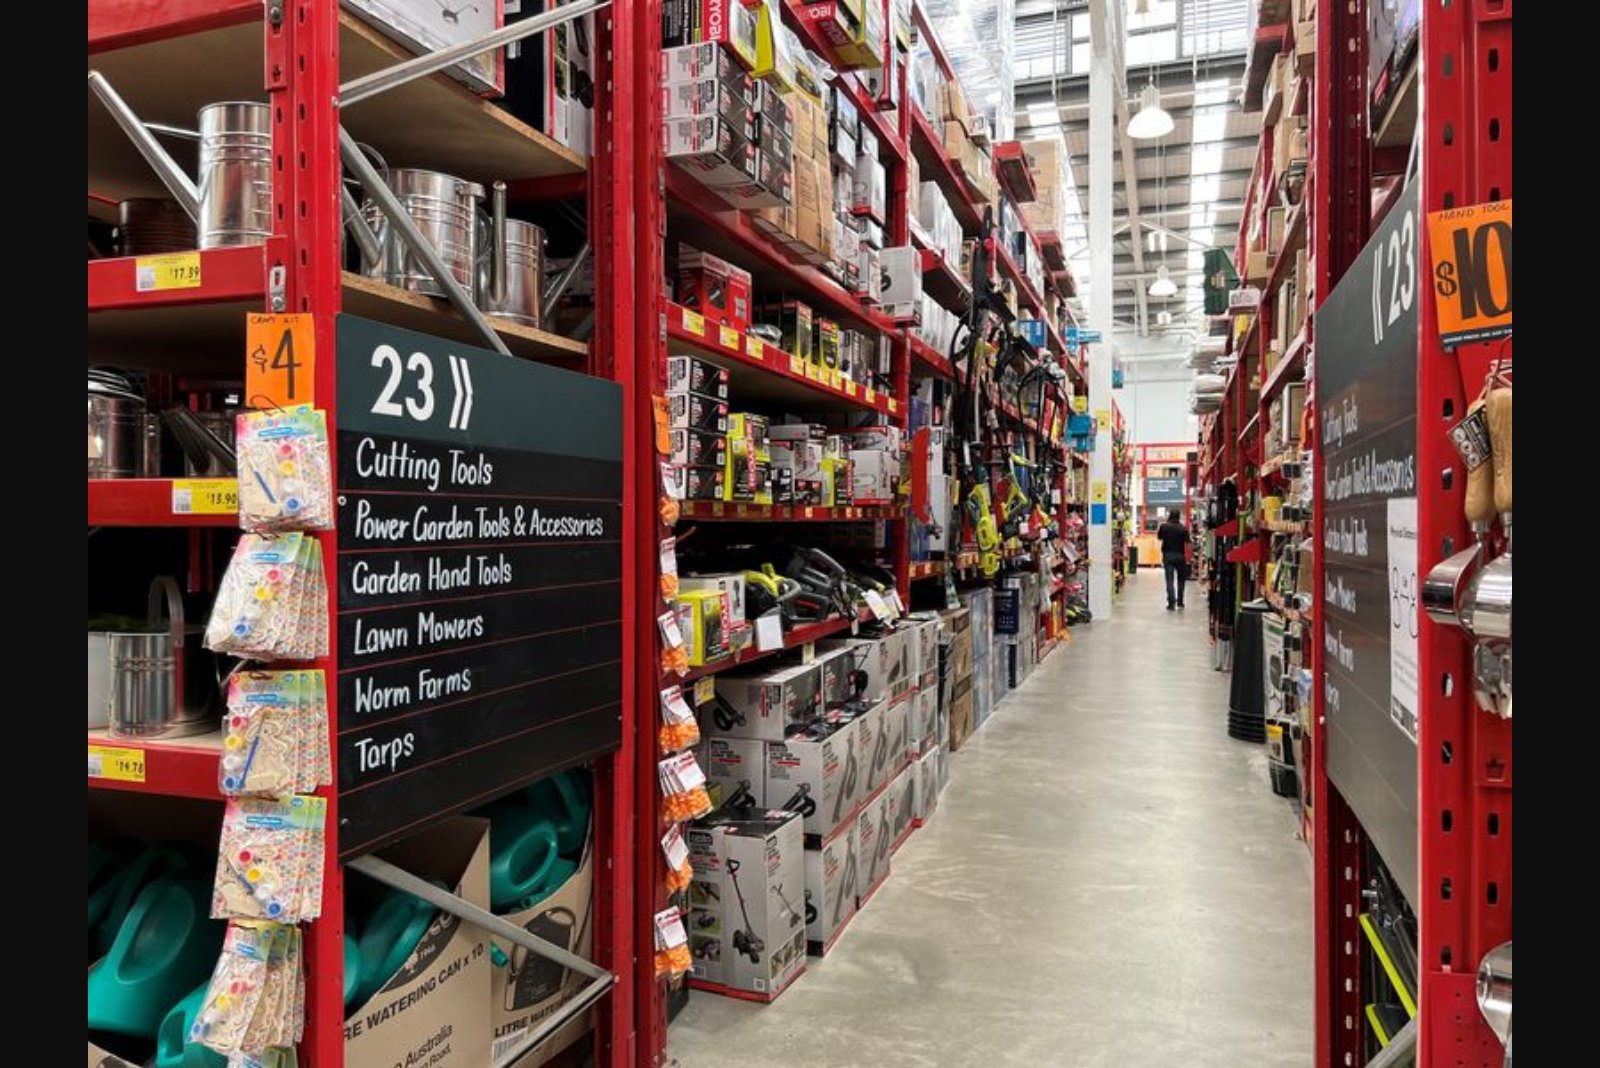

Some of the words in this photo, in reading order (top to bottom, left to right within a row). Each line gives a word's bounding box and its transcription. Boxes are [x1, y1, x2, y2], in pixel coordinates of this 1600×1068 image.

[1387, 210, 1414, 326] 23
[370, 344, 435, 421] 23
[356, 437, 441, 492] Cutting
[449, 450, 493, 486] Tools
[355, 500, 410, 541] Power
[413, 505, 473, 542] Garden
[475, 506, 511, 539] Tools
[513, 505, 527, 536] &
[529, 508, 603, 537] Accessories
[352, 560, 420, 594] Garden
[428, 555, 471, 591] Hand
[477, 553, 513, 586] Tools
[354, 619, 408, 655] Lawn
[417, 612, 484, 646] Mowers
[355, 676, 411, 713] Worm
[419, 668, 471, 701] Farms
[354, 732, 415, 773] Tarps
[366, 979, 437, 1031] WATERING
[437, 956, 462, 985] CAN
[462, 957, 472, 968] x
[472, 942, 485, 962] 10
[405, 1024, 453, 1064] Australia
[493, 1016, 530, 1038] LITRE
